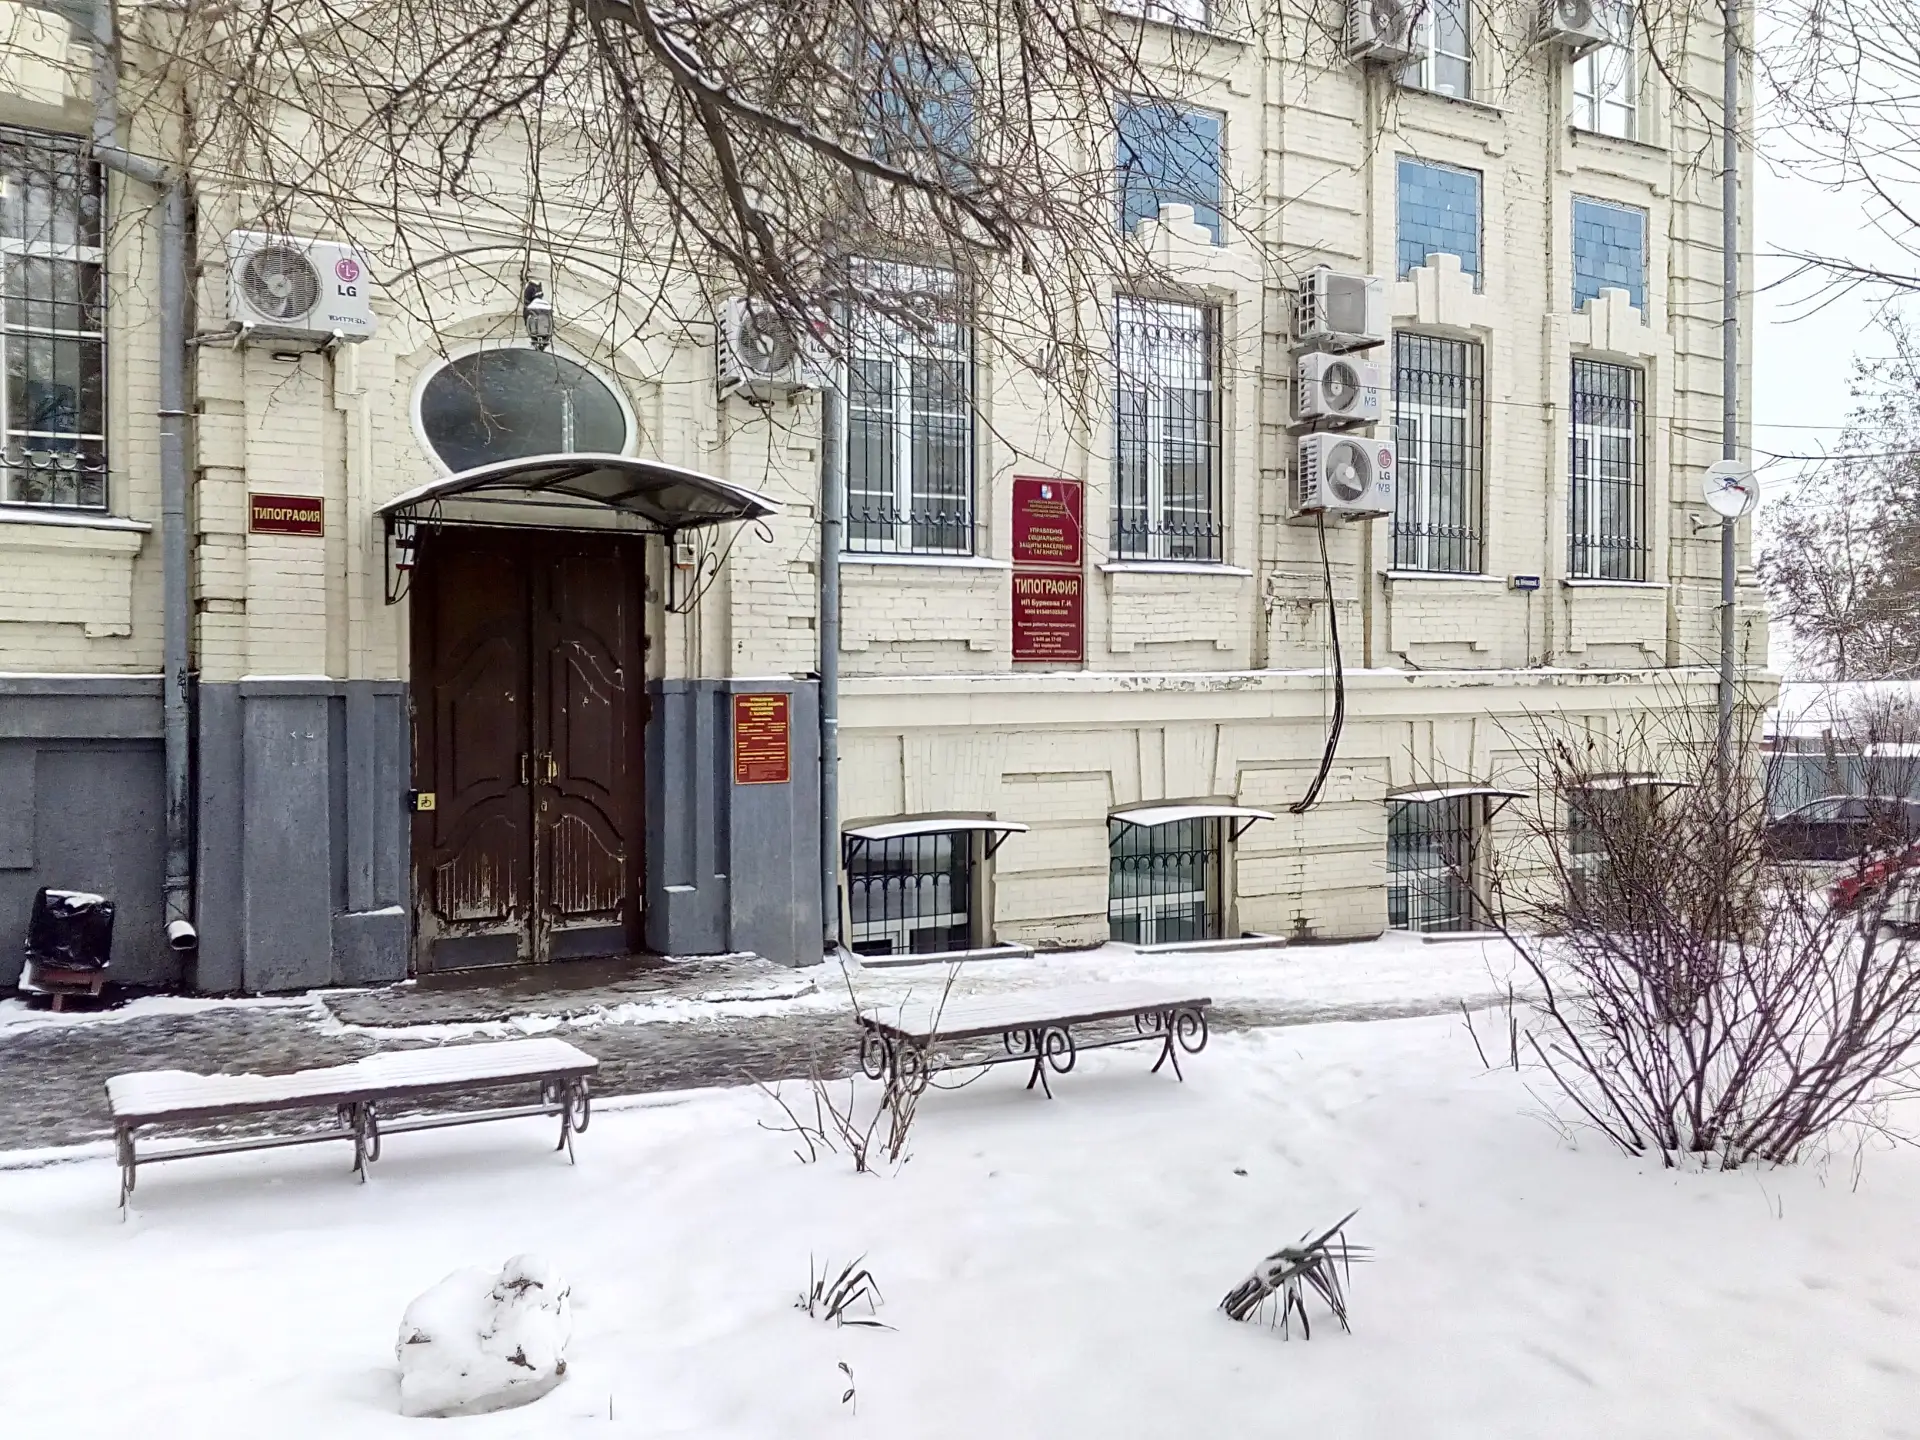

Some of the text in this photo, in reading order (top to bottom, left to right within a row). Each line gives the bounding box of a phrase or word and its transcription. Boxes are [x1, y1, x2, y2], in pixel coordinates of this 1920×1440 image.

[338, 285, 357, 297] LG
[810, 341, 825, 353] LG
[1367, 386, 1377, 395] LG
[1379, 471, 1391, 481] LG
[253, 507, 321, 523] ТИПОГРАФИЯ
[1029, 527, 1063, 535] УПРАВЛЕНИЕ
[1019, 541, 1073, 551] ЗАЩИТЫ НАСЕЛЕНИЯ
[1033, 548, 1063, 556] ТАГАНРОГА
[1014, 578, 1078, 596] ТИПОГРАФИЯ
[1020, 598, 1031, 606] ИП
